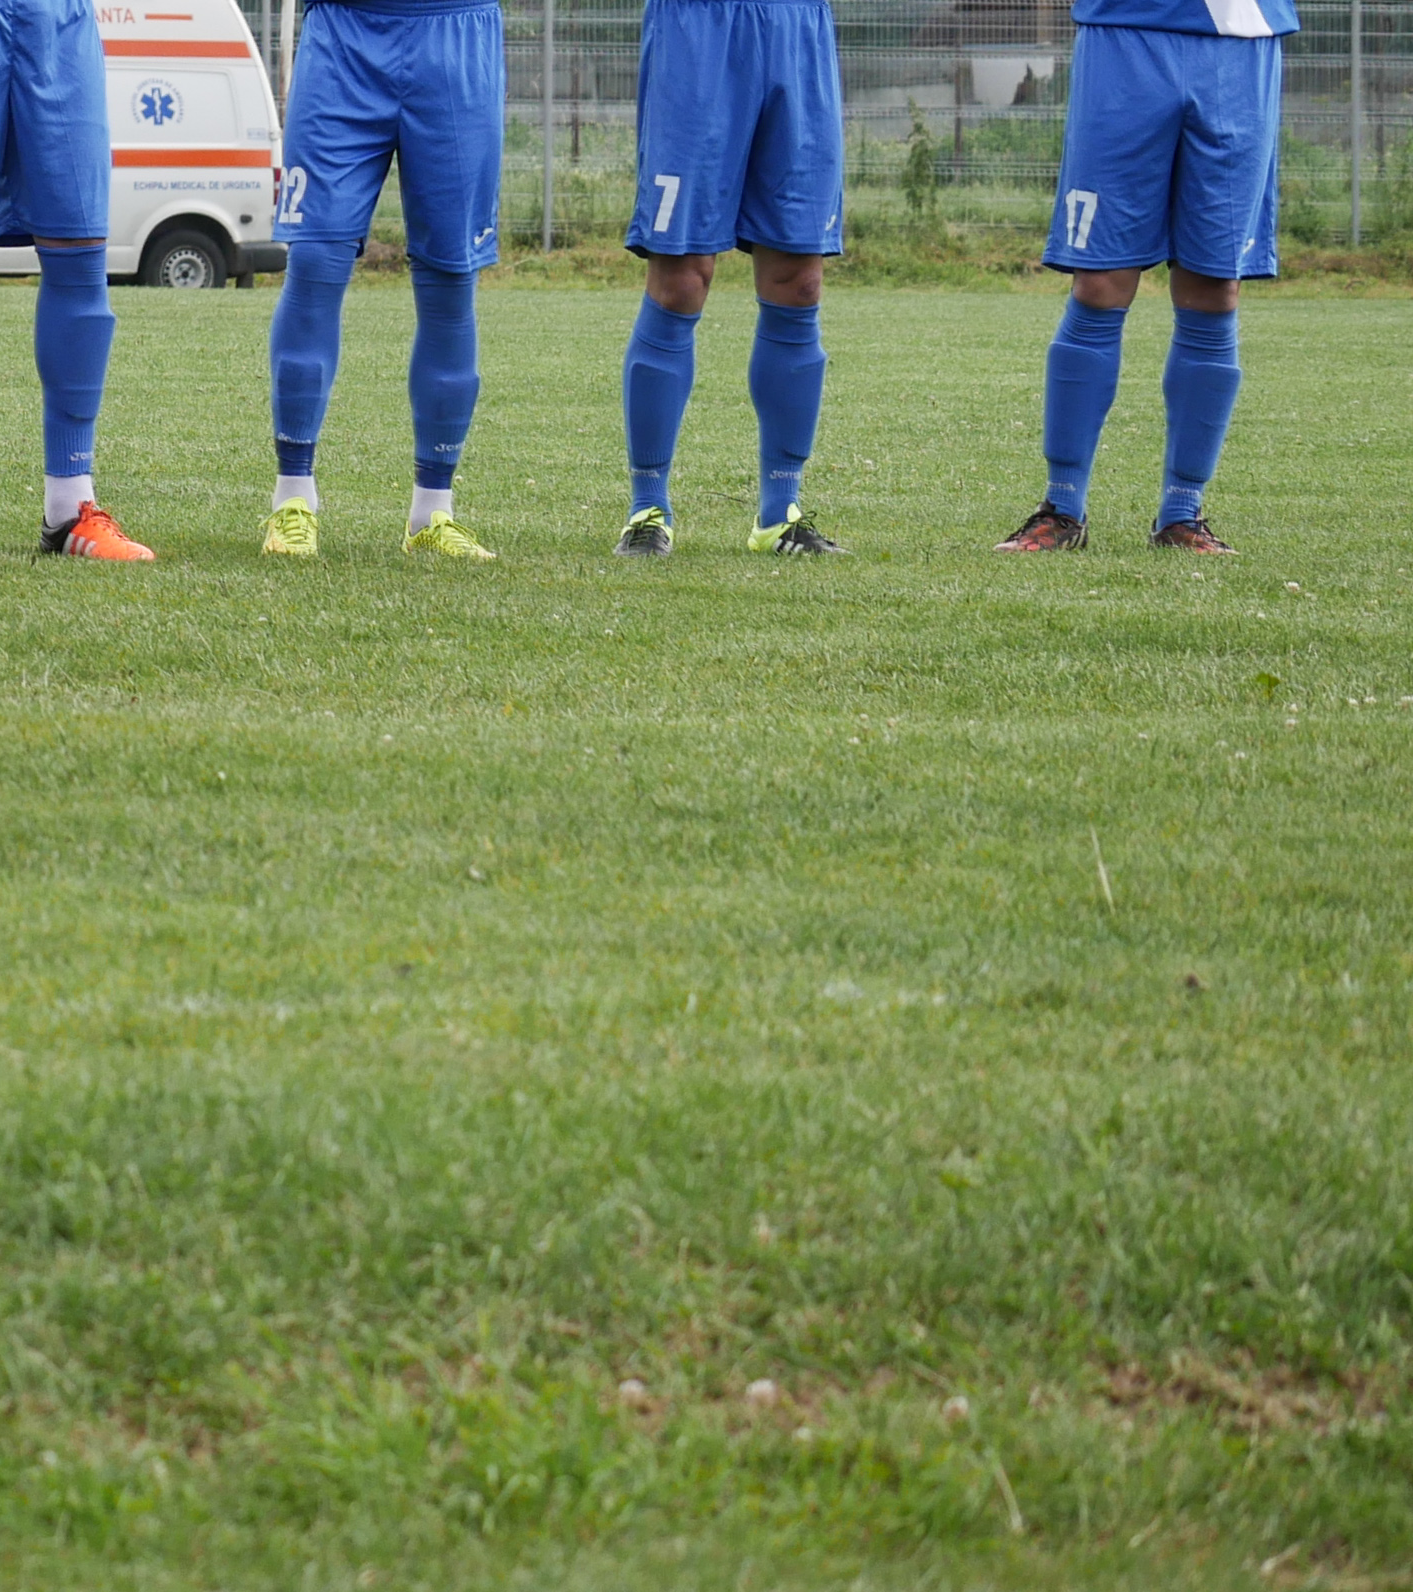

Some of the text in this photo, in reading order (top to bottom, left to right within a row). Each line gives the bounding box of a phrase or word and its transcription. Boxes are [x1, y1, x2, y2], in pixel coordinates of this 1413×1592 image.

[170, 181, 207, 191] MEDICAL
[209, 181, 220, 190] DE
[654, 174, 681, 232] 7
[1065, 188, 1098, 248] 17
